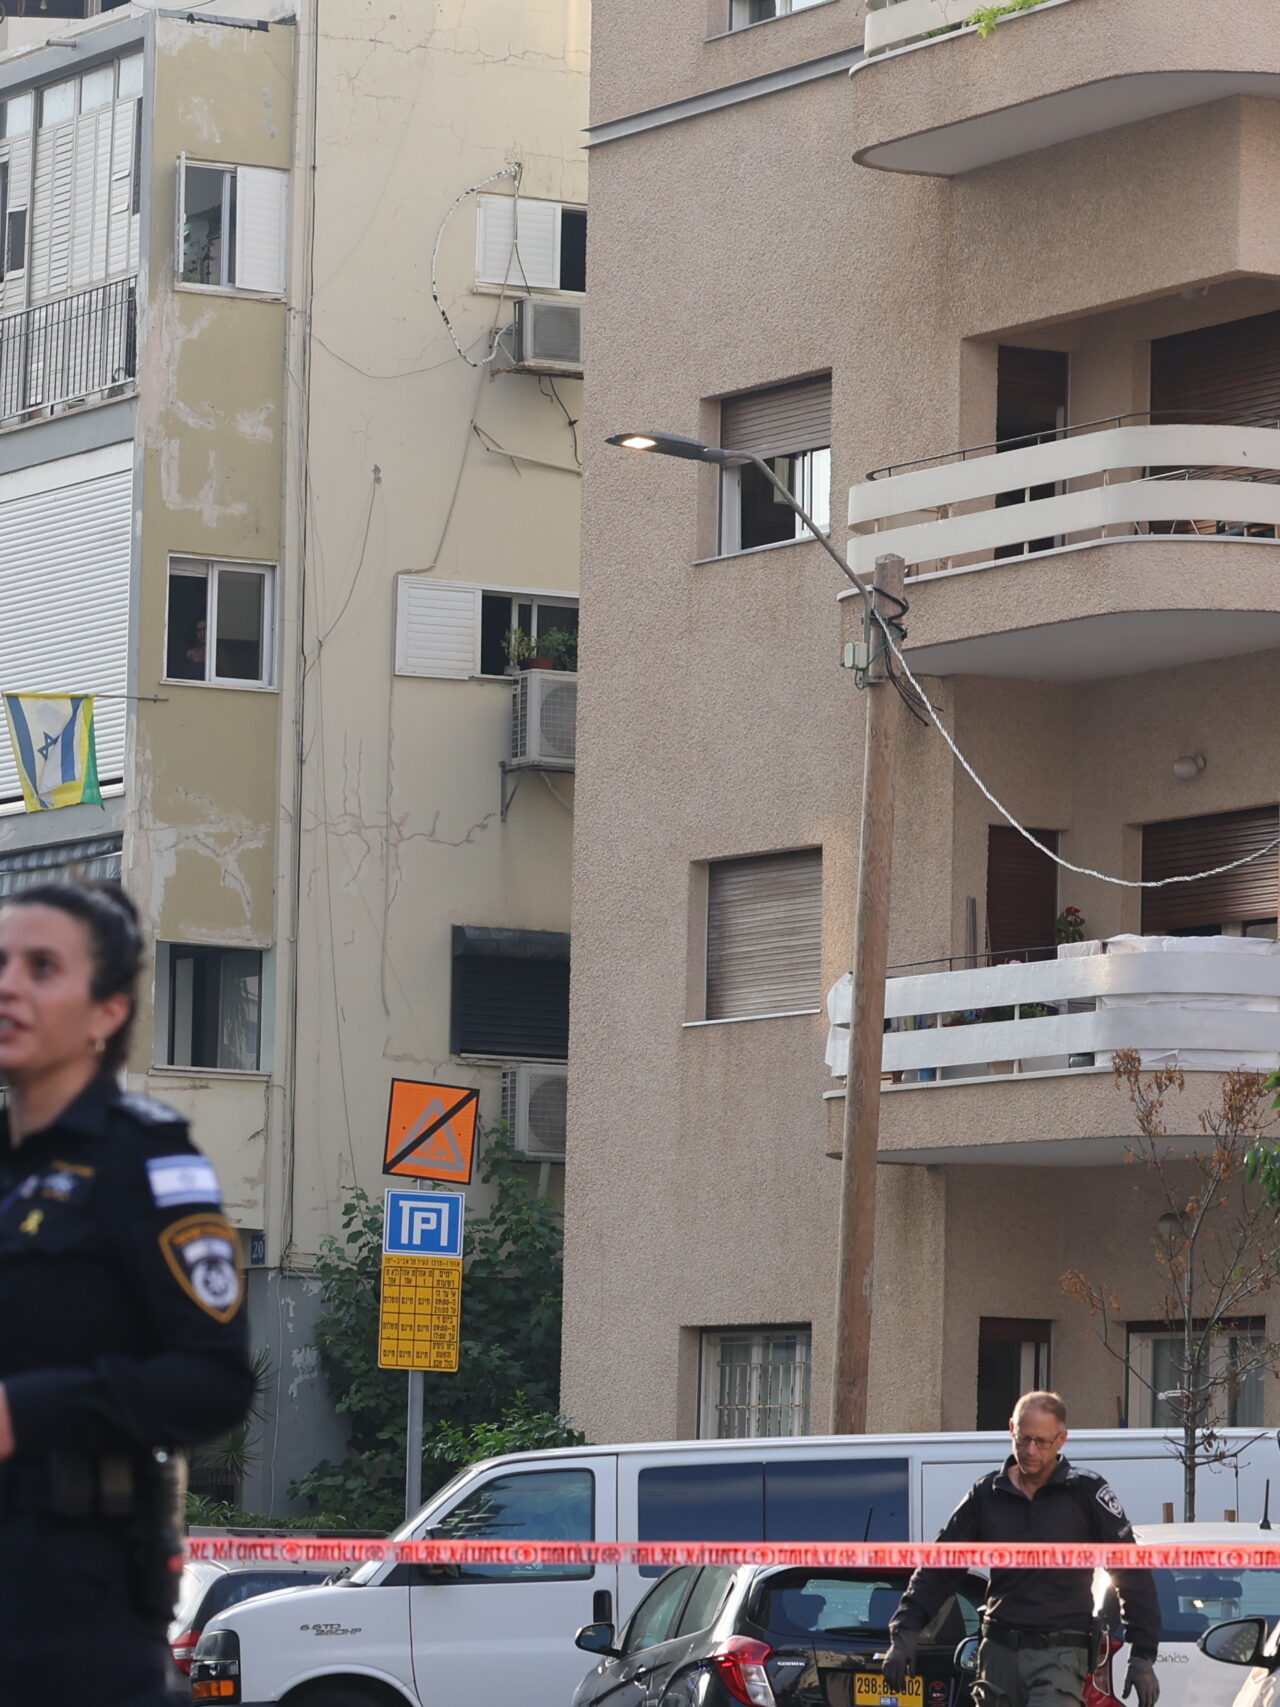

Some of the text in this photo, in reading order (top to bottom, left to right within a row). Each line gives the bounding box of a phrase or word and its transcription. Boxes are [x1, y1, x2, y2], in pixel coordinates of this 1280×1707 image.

[253, 1240, 264, 1258] 20
[235, 1543, 277, 1560] מעבר
[305, 1544, 362, 1561] משטרת
